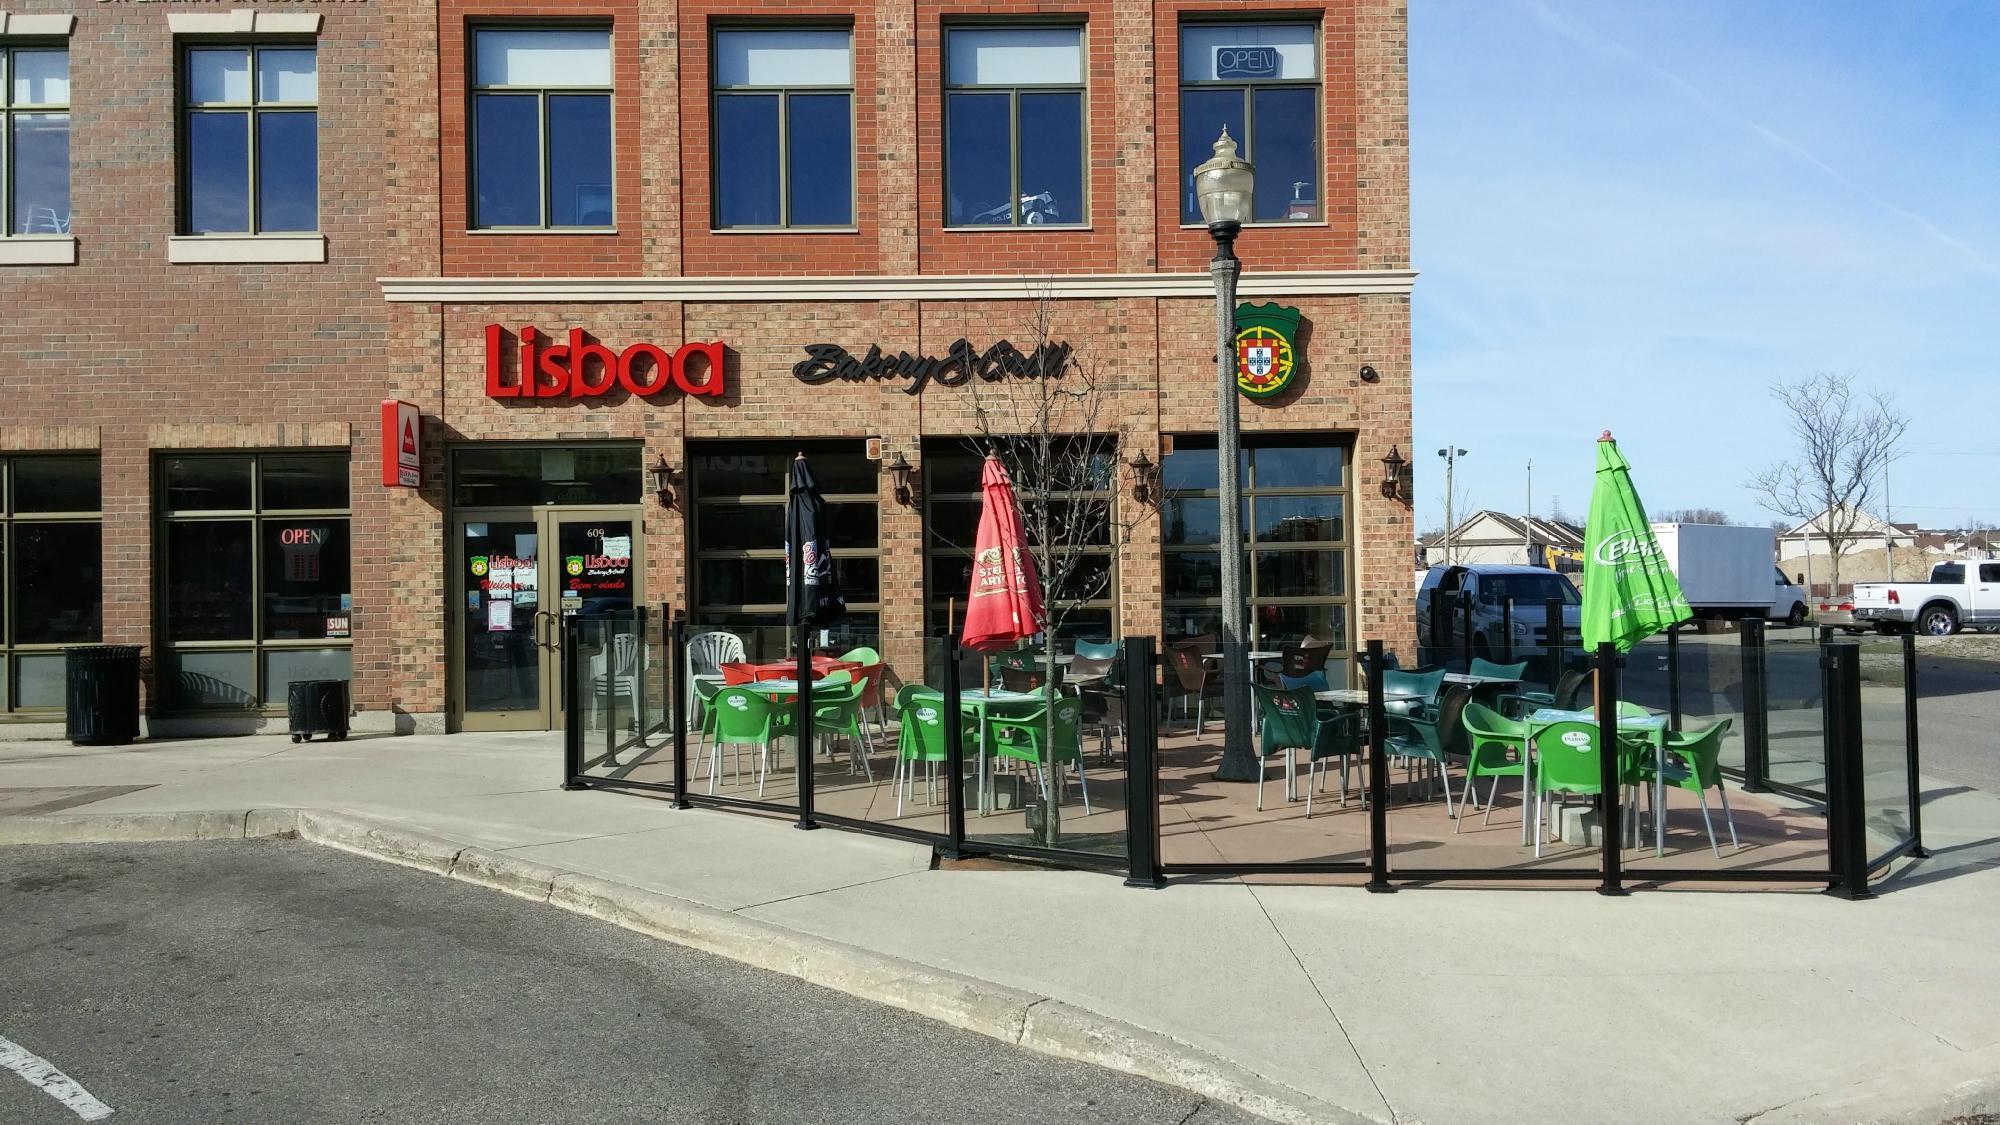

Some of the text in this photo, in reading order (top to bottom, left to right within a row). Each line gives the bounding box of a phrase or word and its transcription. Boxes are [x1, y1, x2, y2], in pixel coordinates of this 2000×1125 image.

[1219, 50, 1275, 69] OPEN
[485, 323, 725, 398] Lisboa
[281, 528, 322, 545] OPEN
[586, 528, 605, 538] 609
[585, 555, 628, 568] Lisboa
[329, 617, 349, 630] SUN
